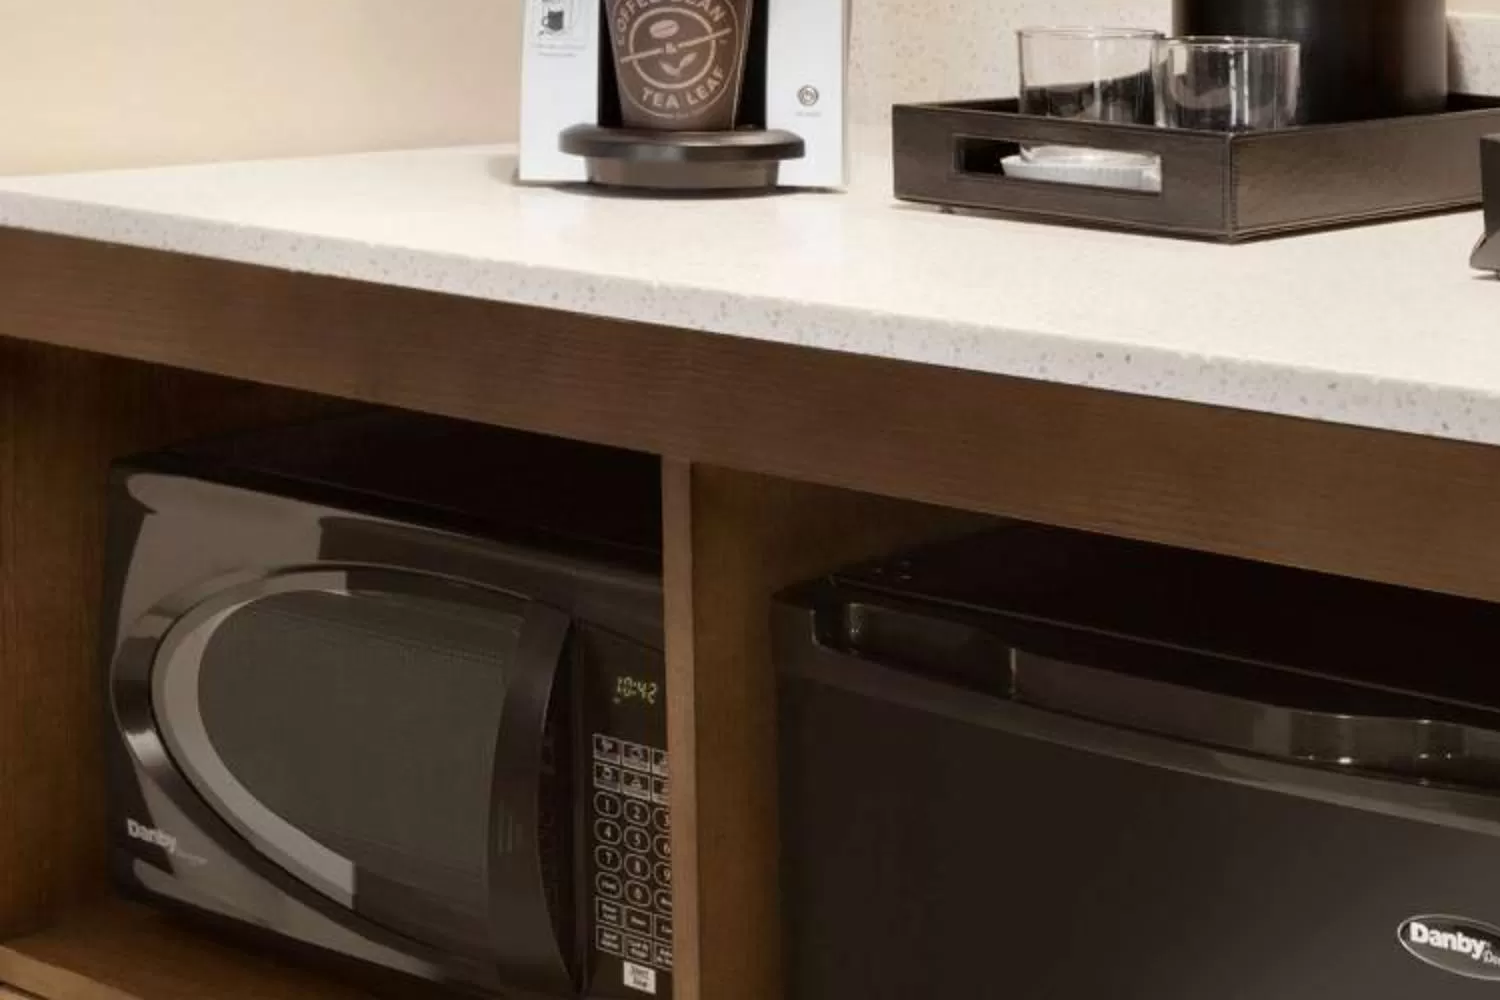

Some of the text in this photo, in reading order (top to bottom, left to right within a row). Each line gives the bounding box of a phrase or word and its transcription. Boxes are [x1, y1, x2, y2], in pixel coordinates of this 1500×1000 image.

[642, 65, 724, 109] TEA LEAF
[616, 675, 658, 705] 10:42
[632, 806, 640, 819] 2
[127, 818, 177, 854] Danby
[604, 825, 612, 838] 4
[604, 851, 613, 865] 7
[1409, 921, 1486, 961] Danby
